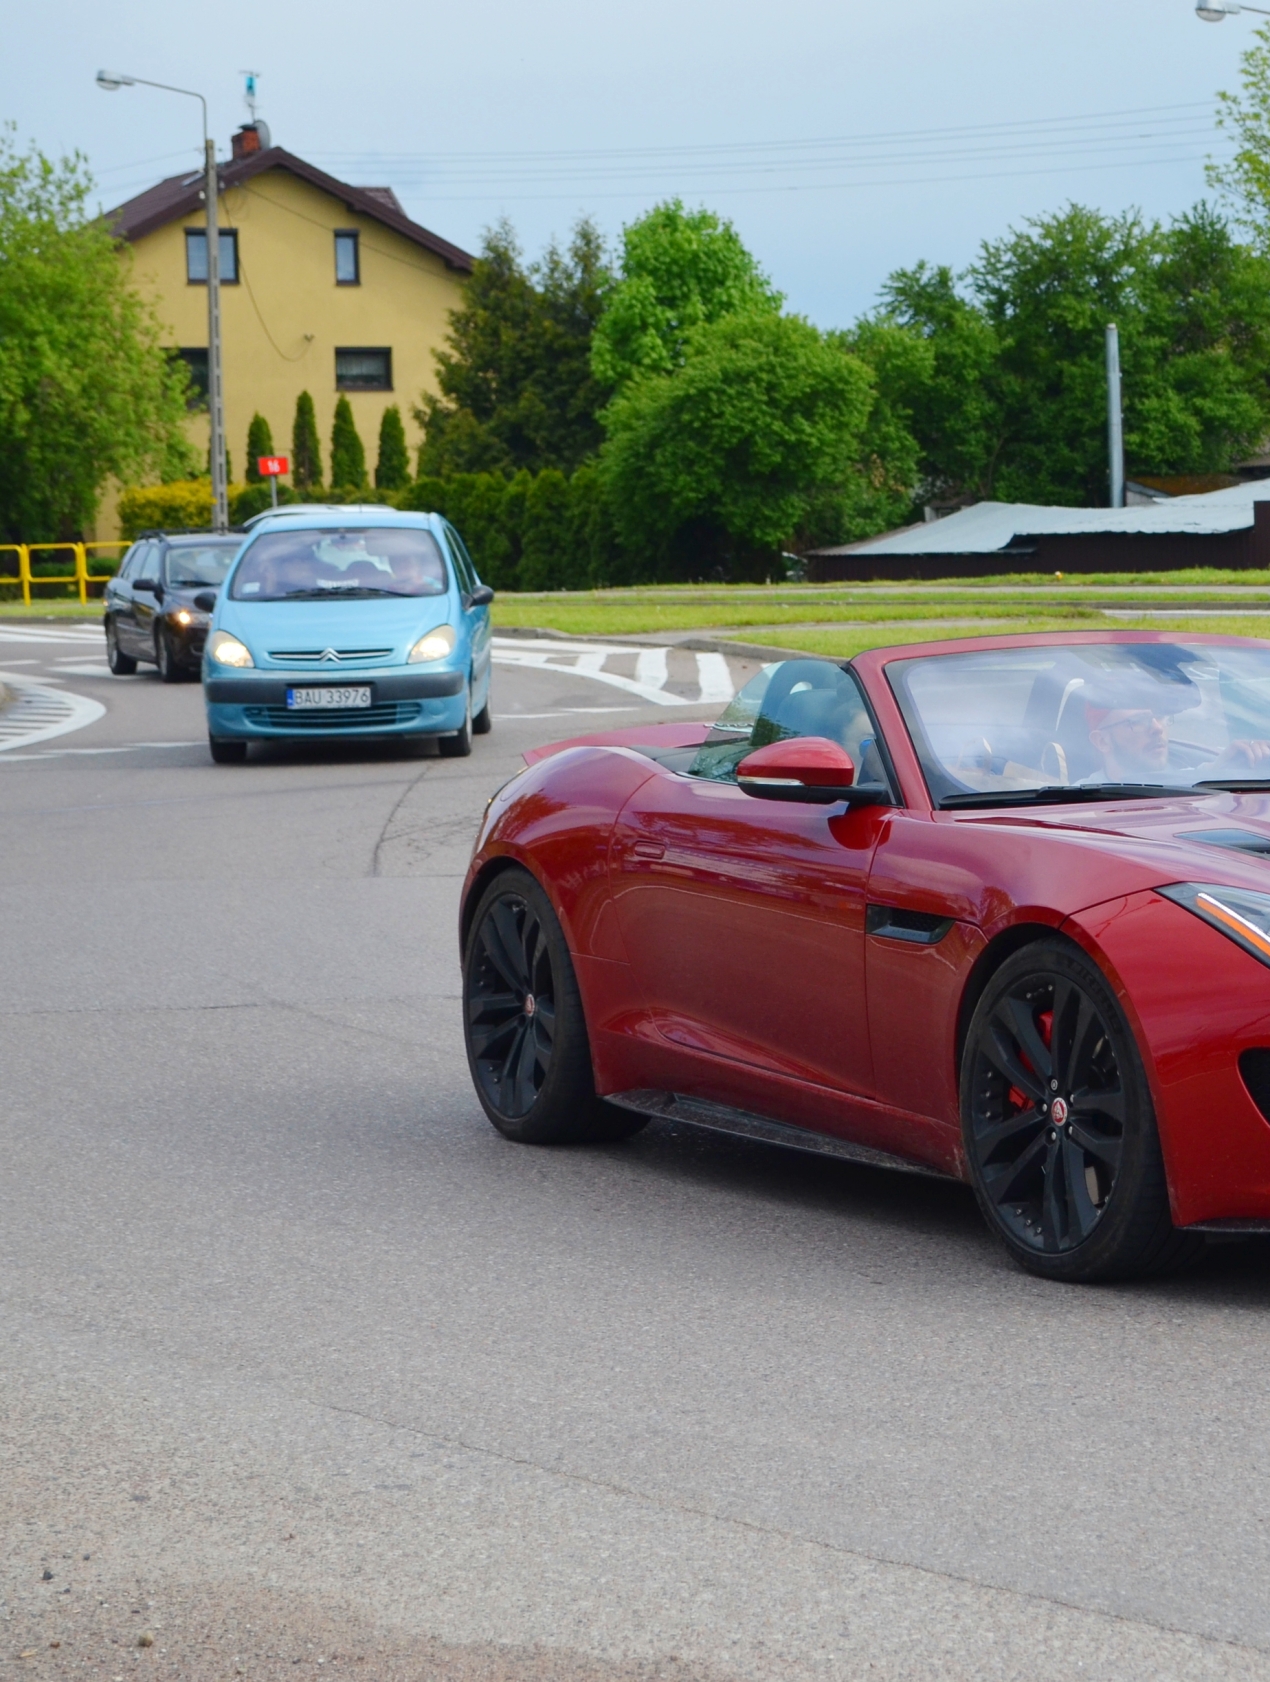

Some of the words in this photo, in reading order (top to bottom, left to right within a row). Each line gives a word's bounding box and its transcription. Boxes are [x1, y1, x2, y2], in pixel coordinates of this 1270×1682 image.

[267, 460, 280, 473] 16
[295, 689, 321, 705] BAU
[327, 688, 370, 705] 33976
